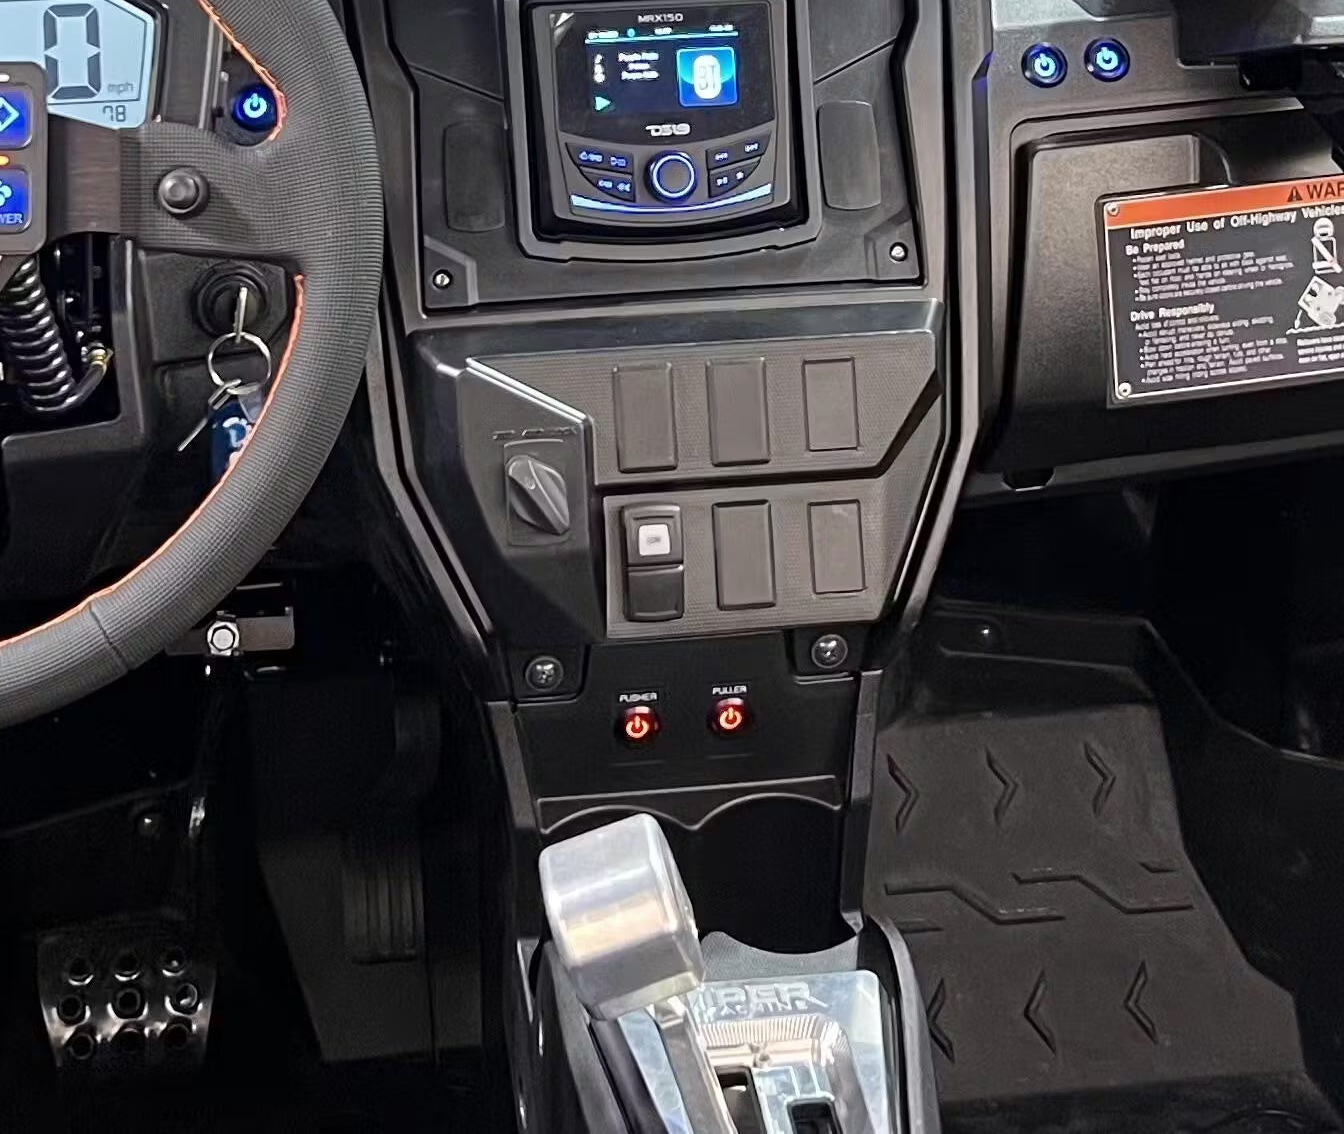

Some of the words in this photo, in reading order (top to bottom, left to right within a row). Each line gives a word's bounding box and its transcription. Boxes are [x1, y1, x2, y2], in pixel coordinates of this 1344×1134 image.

[638, 13, 684, 23] MRX150
[43, 3, 101, 100] 0
[107, 82, 134, 95] mph
[103, 105, 126, 122] 78
[1130, 223, 1180, 240] Improper
[1186, 220, 1208, 233] Use
[1213, 218, 1224, 230] of
[1230, 210, 1296, 228] Off-Highway
[1126, 244, 1138, 256] Be
[1130, 310, 1154, 322] Drive
[1158, 303, 1215, 318] Responsibly
[712, 685, 747, 695] PULLER
